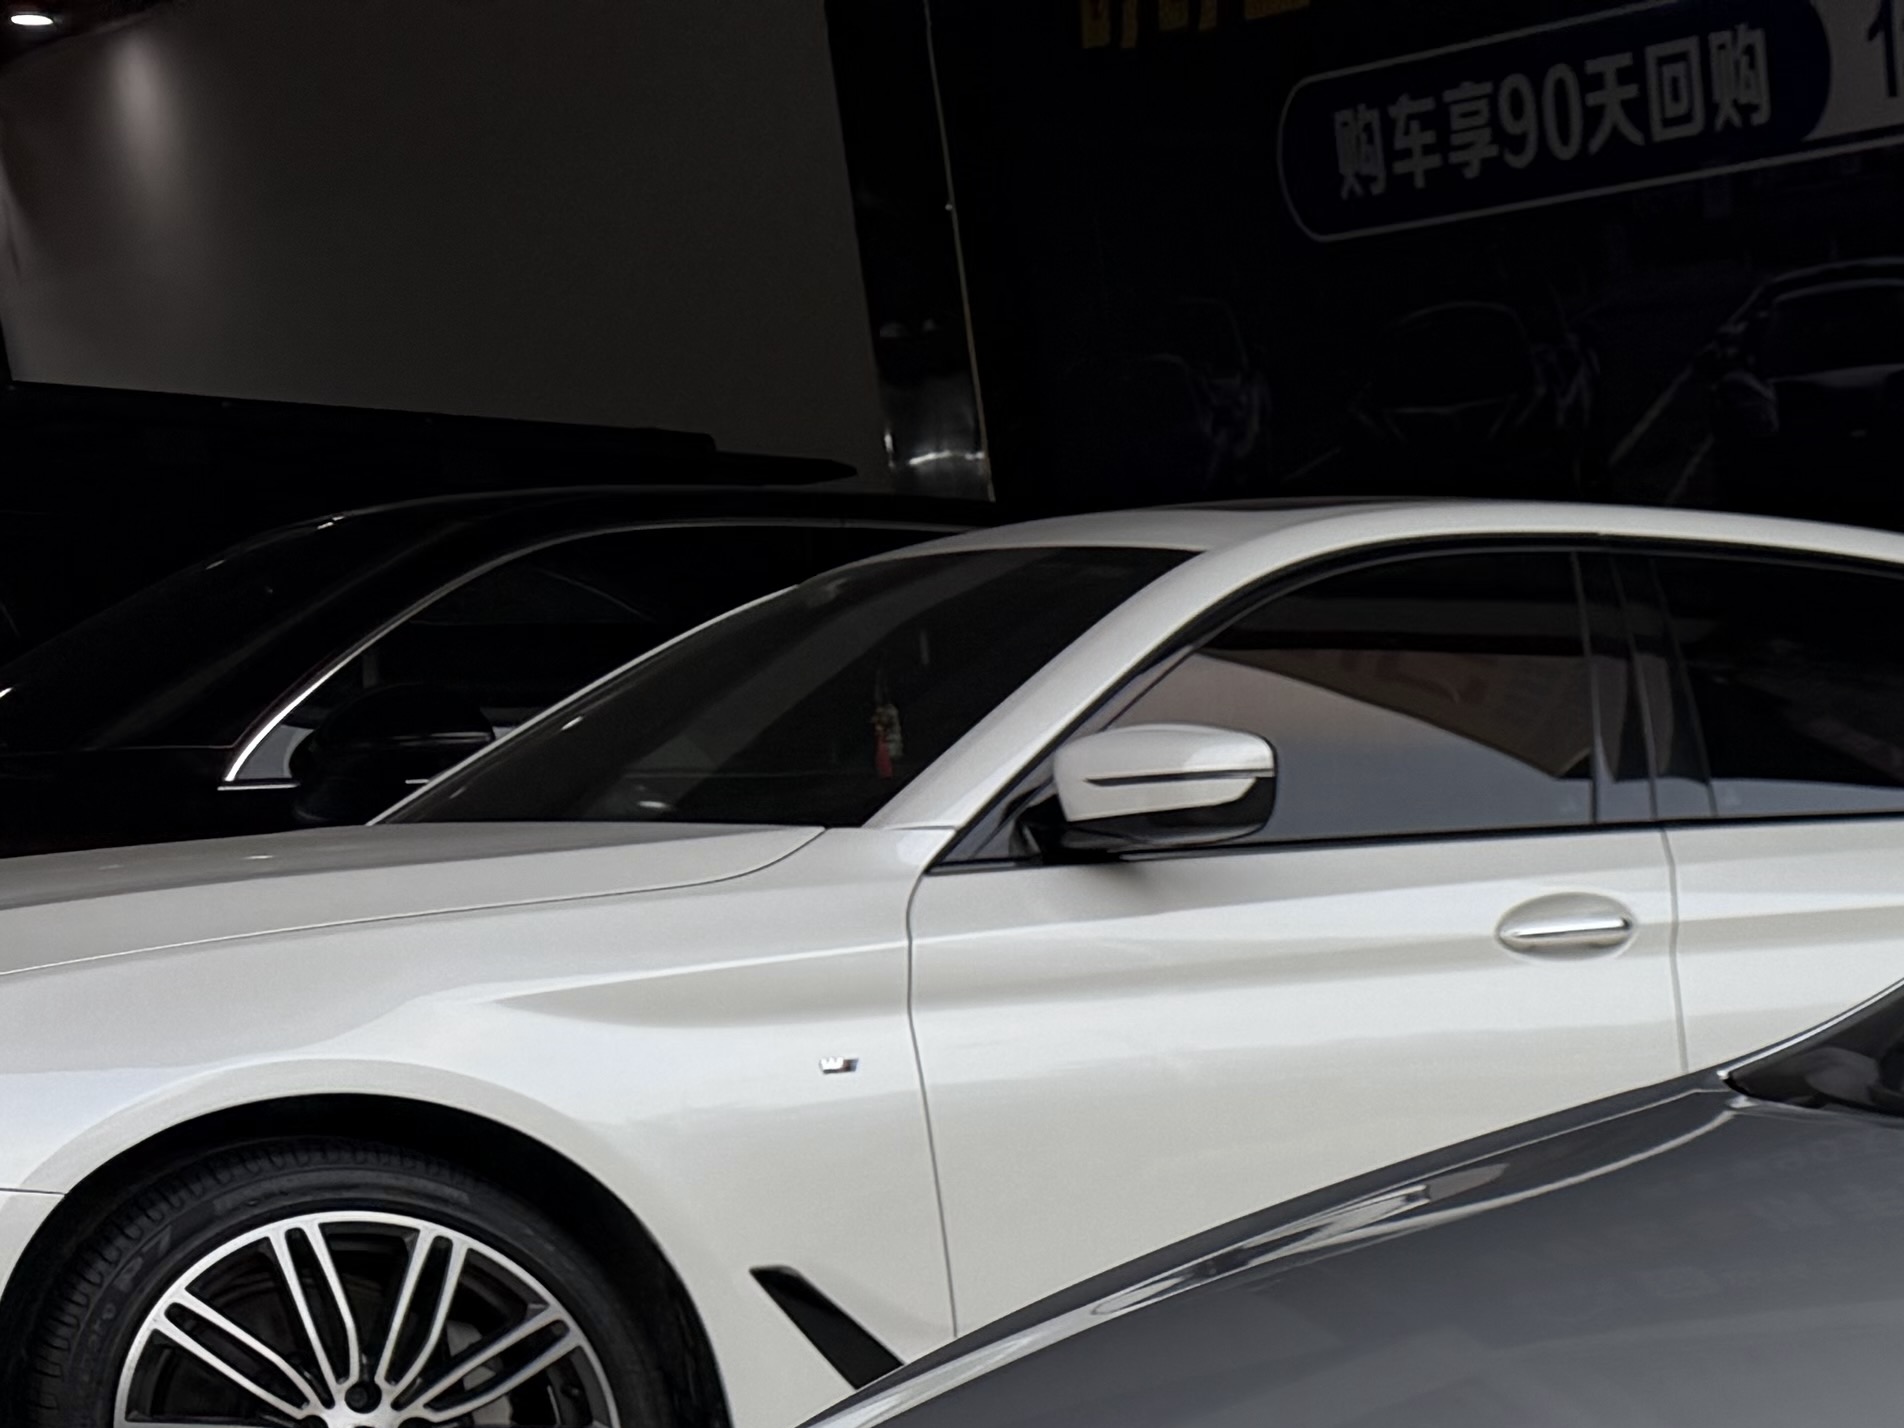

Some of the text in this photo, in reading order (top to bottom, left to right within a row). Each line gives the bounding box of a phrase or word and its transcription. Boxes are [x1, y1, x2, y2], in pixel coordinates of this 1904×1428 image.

[1333, 24, 1772, 200] 购车享90天回购
